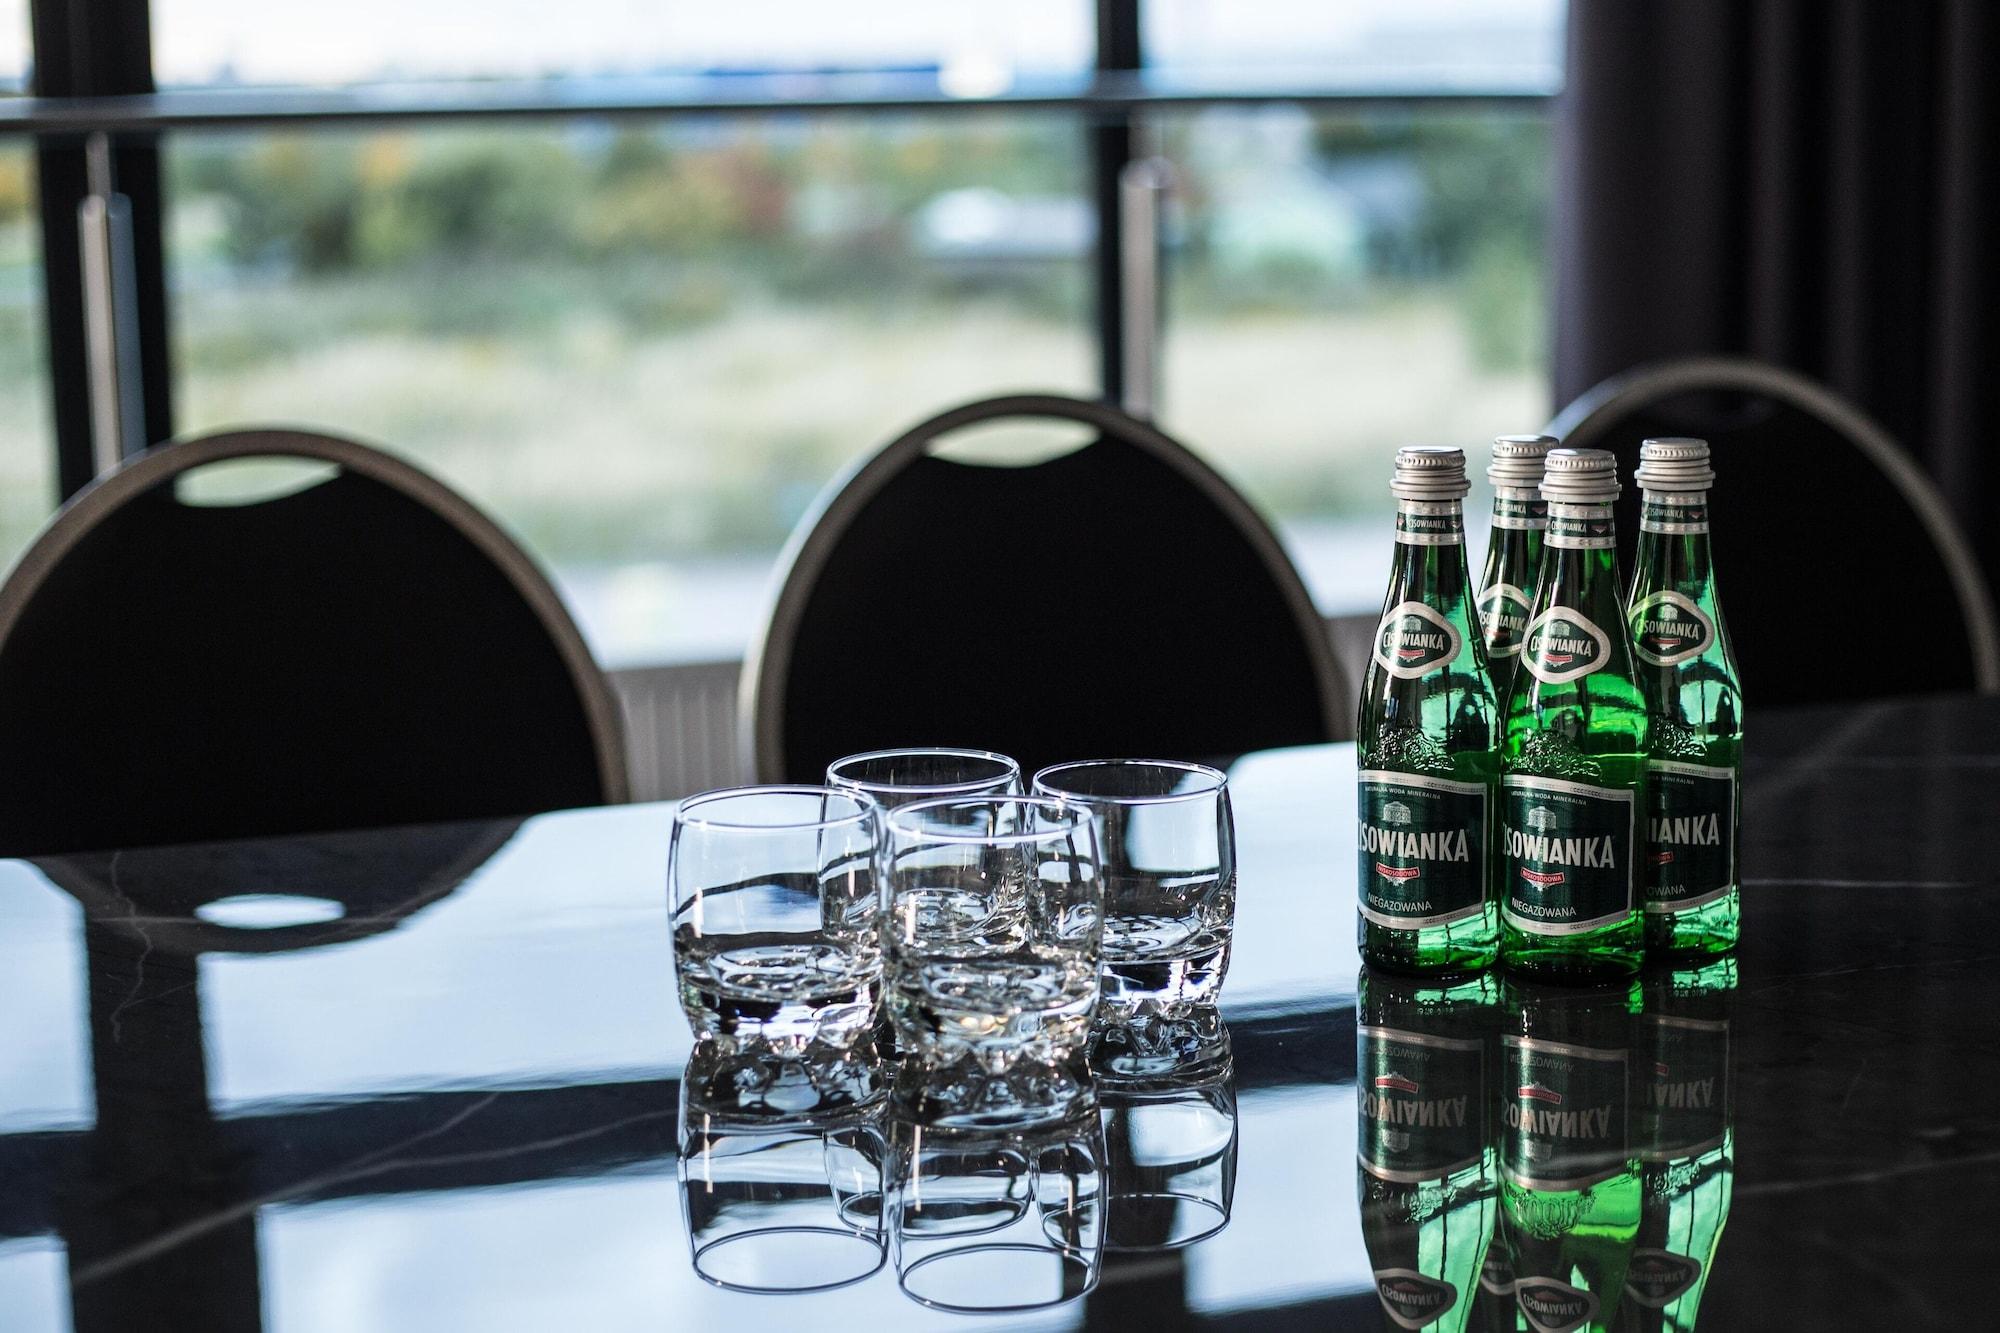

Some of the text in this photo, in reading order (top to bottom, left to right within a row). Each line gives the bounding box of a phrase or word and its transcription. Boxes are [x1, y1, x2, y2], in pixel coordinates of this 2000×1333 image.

[1383, 631, 1444, 651] CISWIANKA
[1530, 635, 1592, 657] CISWIANKA
[1389, 787, 1405, 795] WODA
[1407, 790, 1441, 800] MINERALNA
[1534, 792, 1551, 800] WODA
[1552, 795, 1587, 806] MINERALNA
[1648, 812, 1720, 846] IANKA
[1359, 819, 1469, 863] ISOWIANKA
[1502, 821, 1615, 869] ISOWIANKA
[1367, 892, 1432, 912] NIEGAZOWANA
[1511, 897, 1577, 917] NIEGAZOWANA
